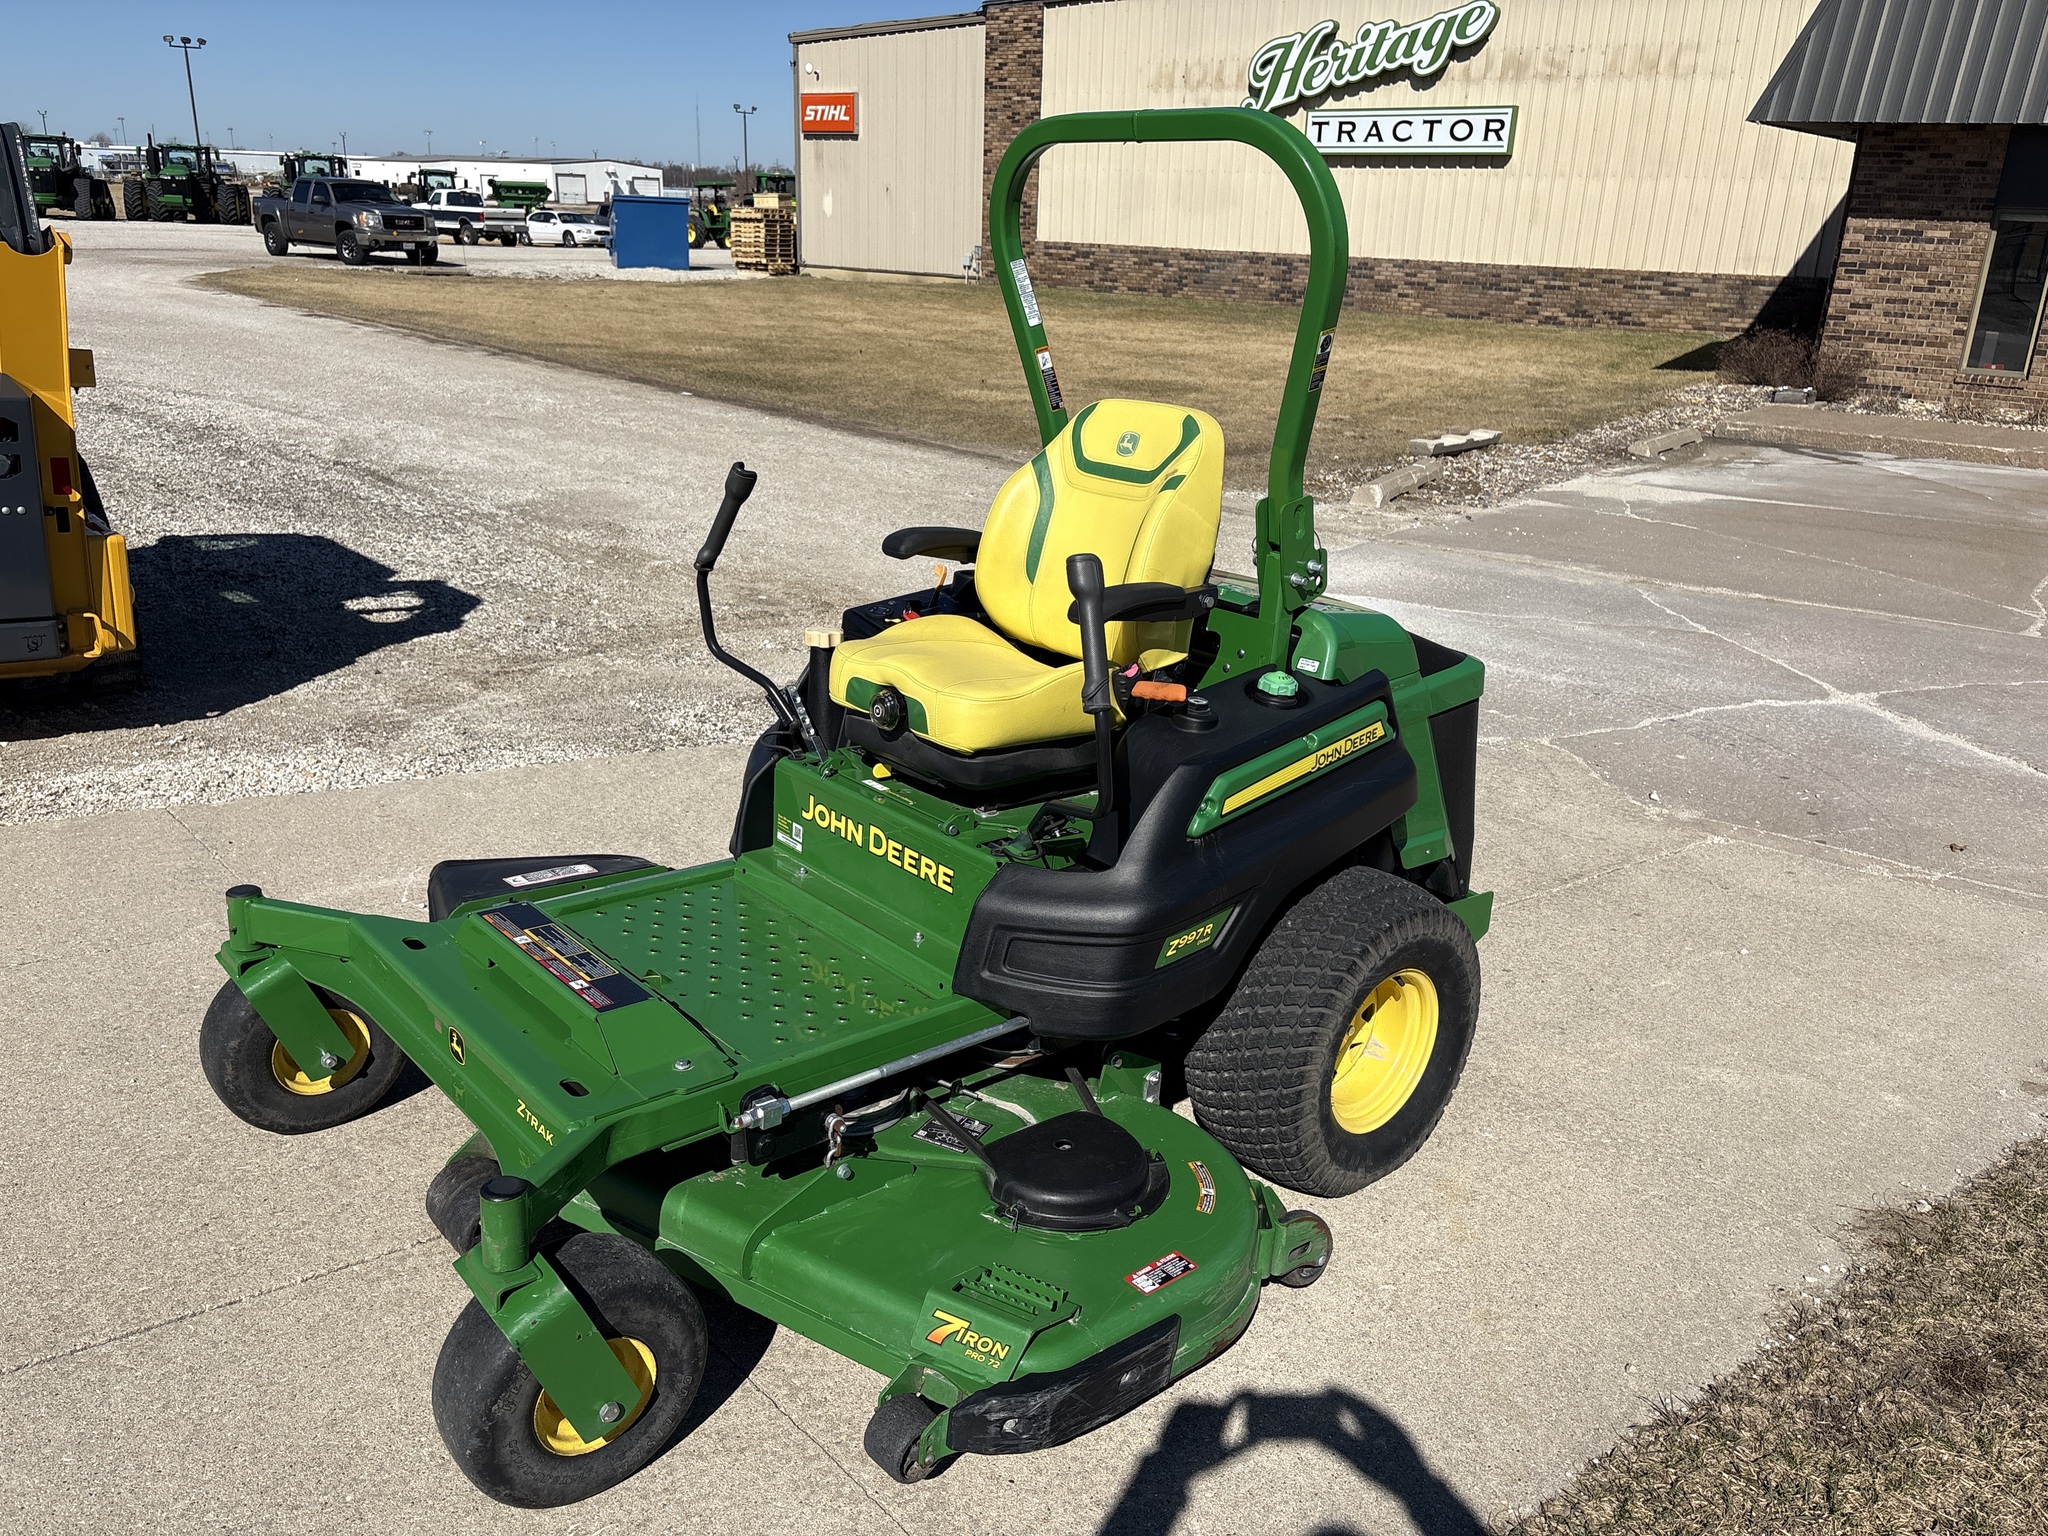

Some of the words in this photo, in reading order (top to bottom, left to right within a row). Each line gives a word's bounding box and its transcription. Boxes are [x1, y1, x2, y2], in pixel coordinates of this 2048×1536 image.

[1243, 0, 1498, 110] Heritage
[804, 105, 850, 122] STIHL
[1311, 118, 1506, 143] TRACTOR
[1311, 744, 1342, 771] JOHN
[1344, 727, 1379, 754] DEERE
[801, 793, 864, 847] JOHN
[868, 823, 955, 894] DEERE
[1166, 923, 1214, 957] Z997R
[517, 1098, 555, 1146] ZTRAK
[964, 1349, 986, 1362] PRO
[987, 1358, 1001, 1369] 72
